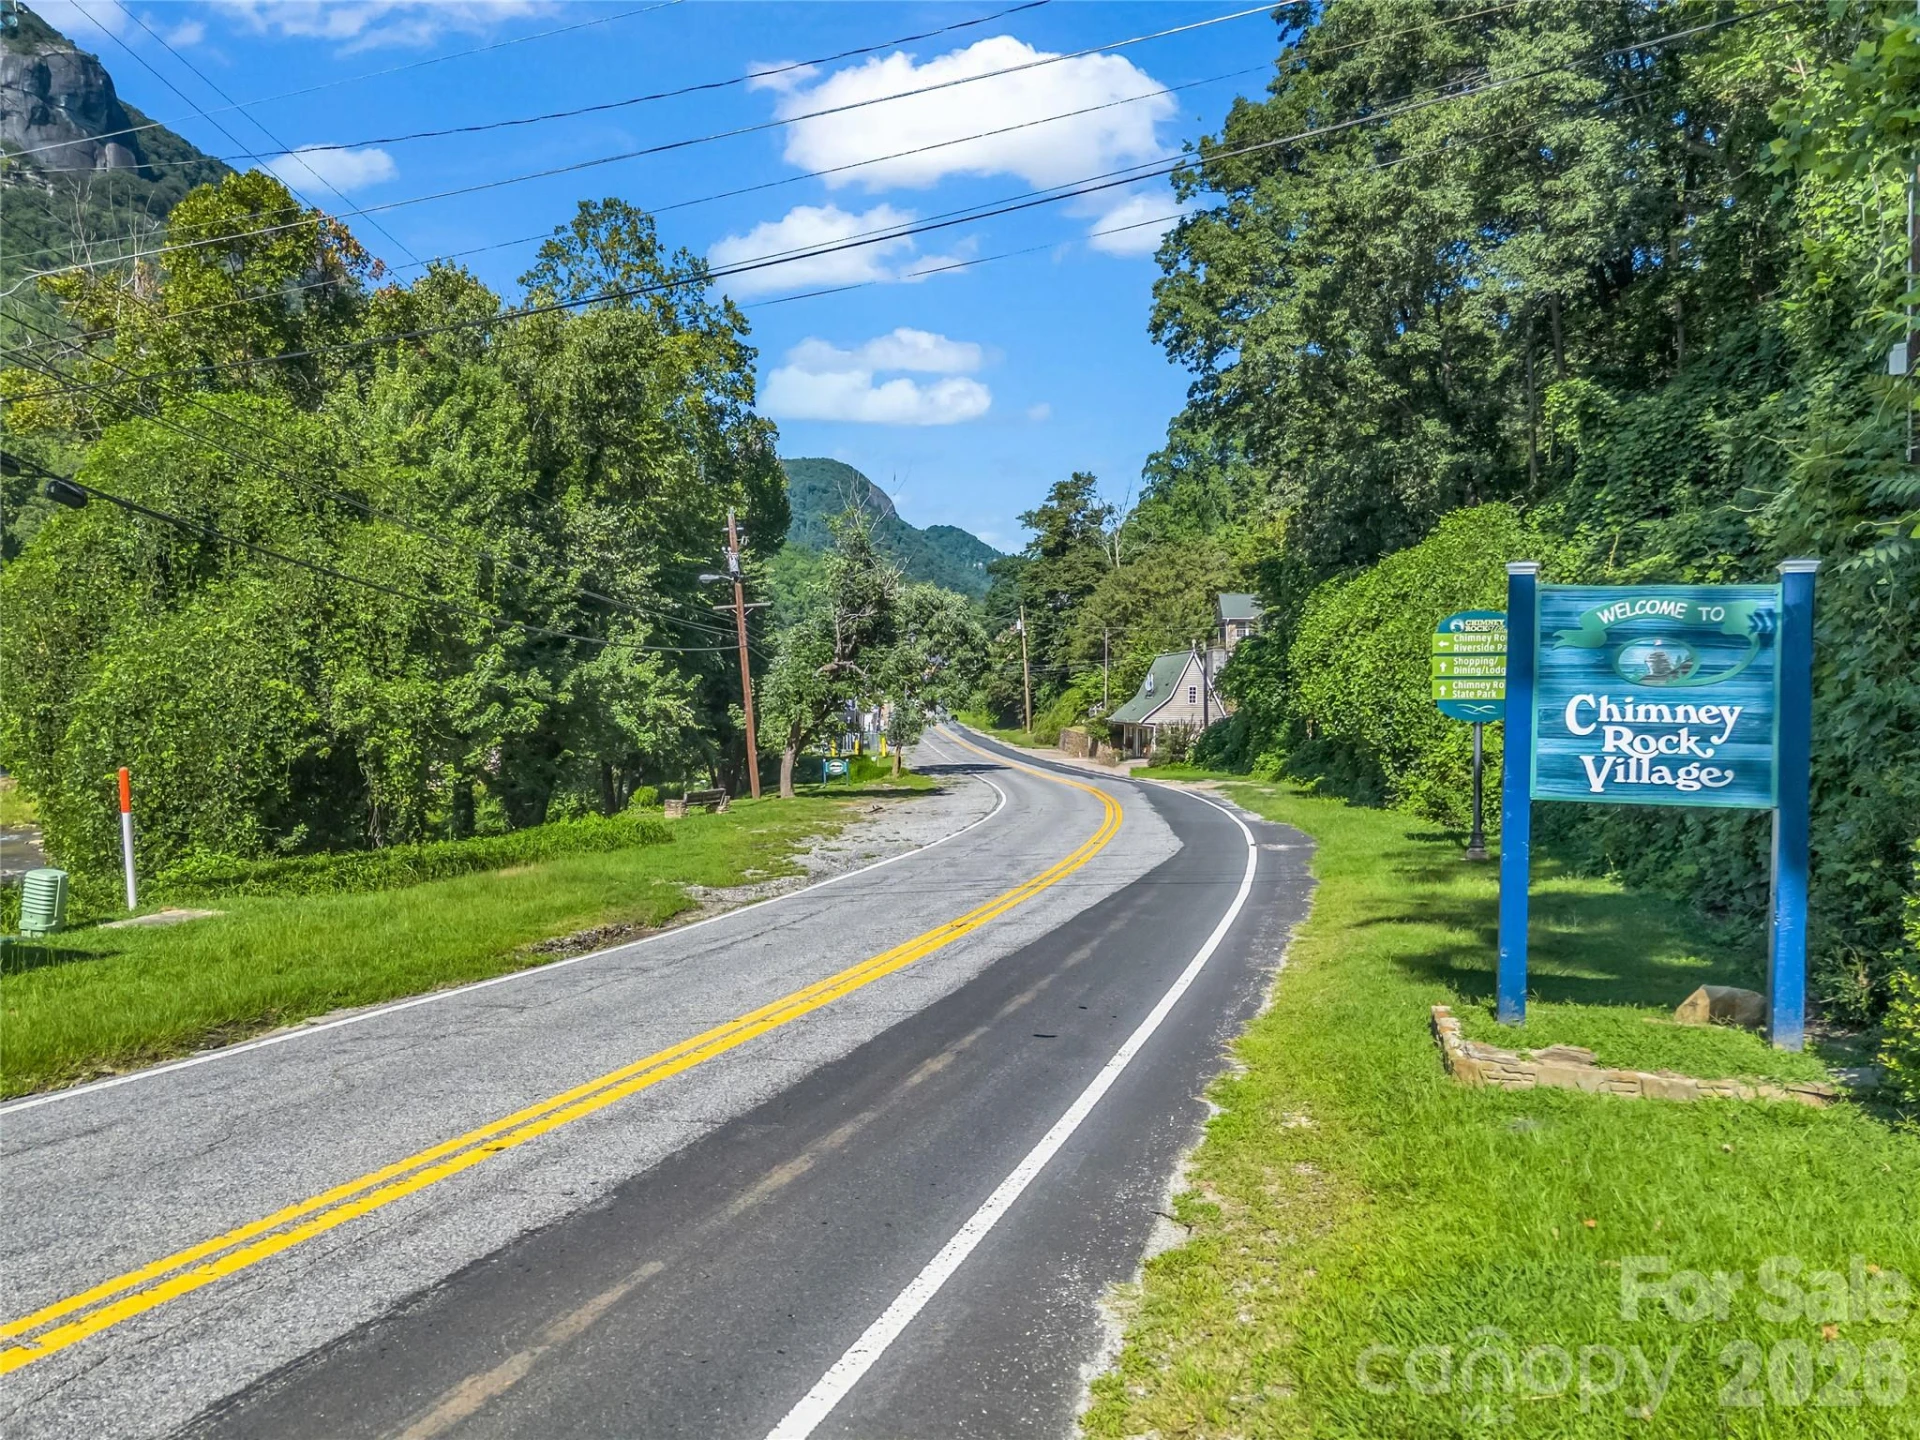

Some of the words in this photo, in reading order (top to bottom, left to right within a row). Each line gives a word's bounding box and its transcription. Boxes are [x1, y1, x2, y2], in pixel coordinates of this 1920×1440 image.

[1597, 600, 1687, 624] WELCOME
[1698, 606, 1725, 621] TO
[1453, 634, 1492, 644] Chimney
[1453, 643, 1495, 652] Riverside
[1453, 656, 1499, 667] Shopping/
[1452, 681, 1491, 691] Chimney
[1452, 690, 1475, 699] State
[1476, 690, 1497, 699] Park
[1565, 694, 1743, 745] Chimney
[1601, 725, 1714, 760] Rock
[1579, 755, 1735, 793] Village
